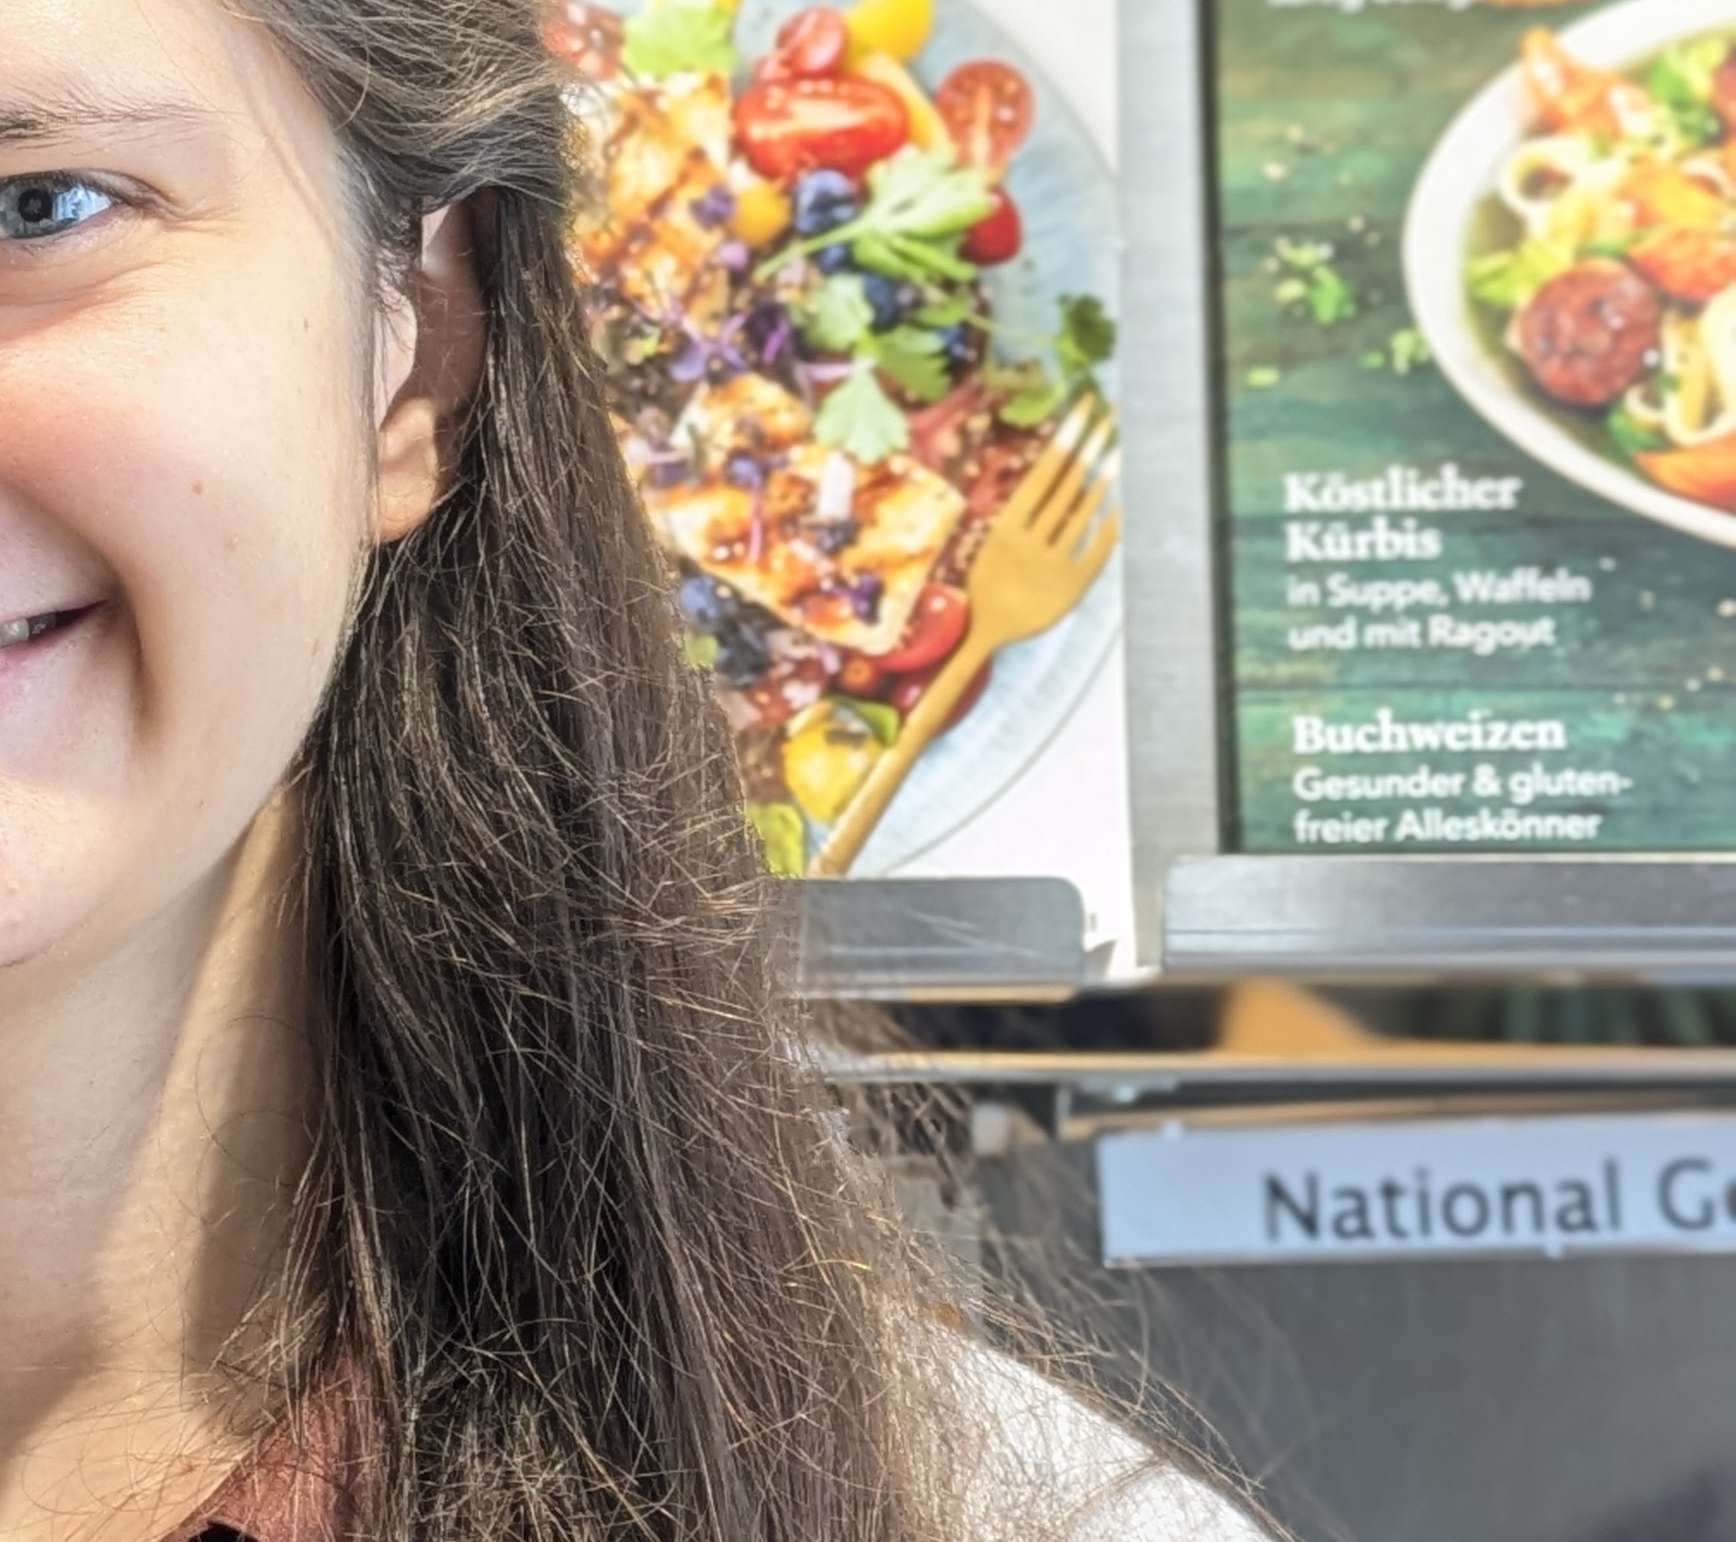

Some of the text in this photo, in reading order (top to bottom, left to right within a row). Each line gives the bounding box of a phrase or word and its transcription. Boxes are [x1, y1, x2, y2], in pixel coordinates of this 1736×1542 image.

[1282, 463, 1522, 512] Köstlicher
[1283, 515, 1442, 561] Kürbis
[1287, 567, 1591, 613] in Suppe, Waffeln
[1288, 614, 1555, 655] und mit Ragout
[1291, 708, 1567, 754] Buchweizen
[1292, 761, 1633, 806] Gesunder & gluten-
[1293, 805, 1602, 843] freier Alleskönner
[1262, 1159, 1622, 1243] National
